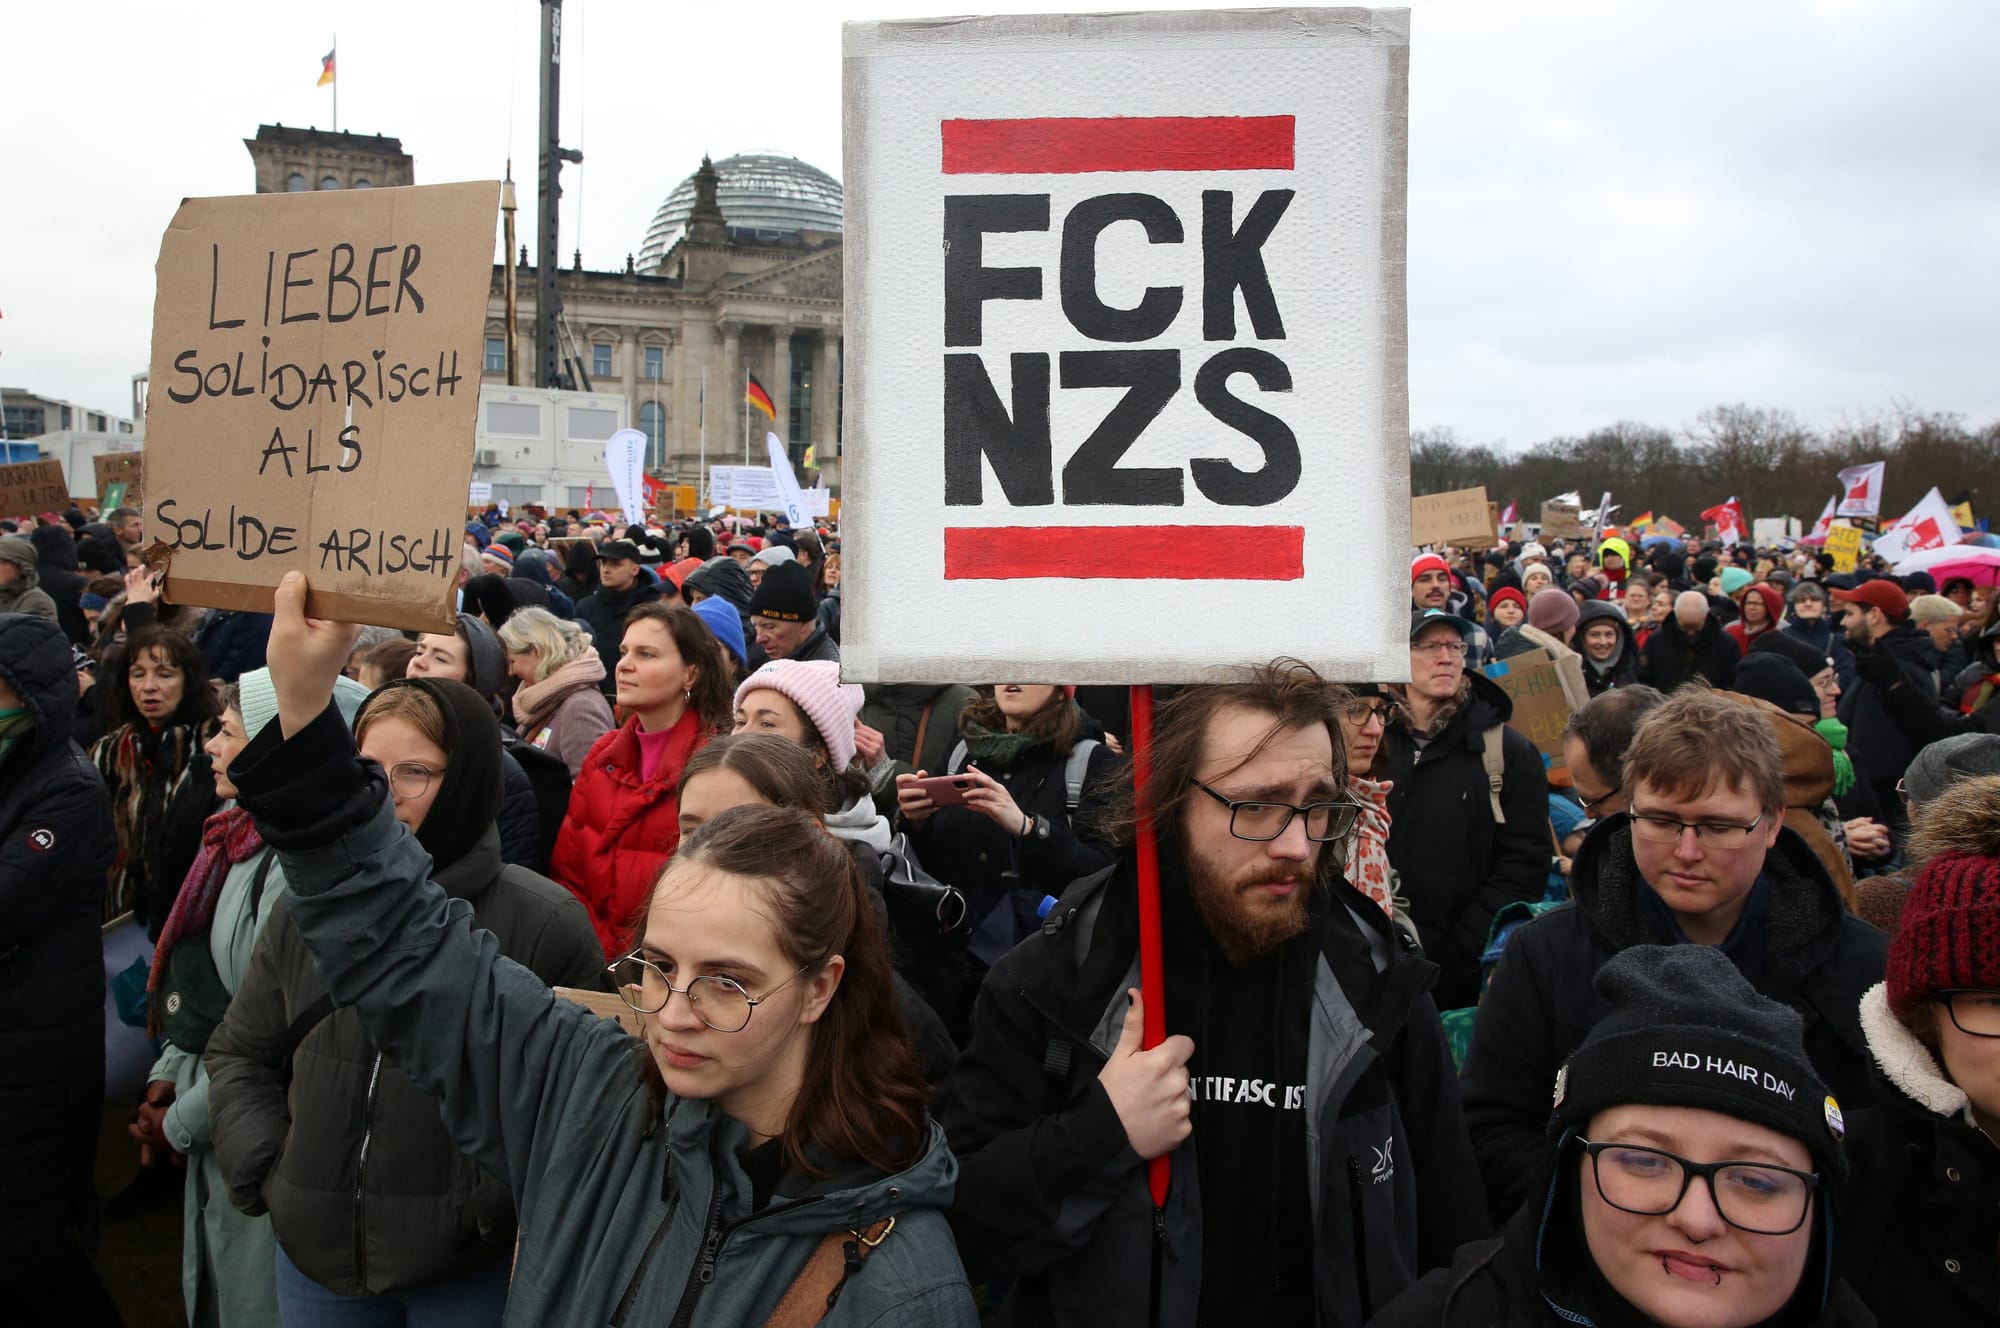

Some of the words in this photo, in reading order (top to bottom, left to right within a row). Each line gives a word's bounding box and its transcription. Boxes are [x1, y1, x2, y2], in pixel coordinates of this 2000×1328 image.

[209, 243, 425, 330] LIEBER
[943, 188, 1297, 347] FCK
[258, 425, 362, 478] ALS
[943, 347, 1303, 507] NZS
[154, 499, 298, 561] SOLIDE
[319, 527, 453, 578] ARISCH
[762, 608, 780, 618] MOIN
[1652, 1051, 1700, 1069] BAD
[1706, 1055, 1758, 1085] HAIR
[1763, 1072, 1796, 1101] DAY
